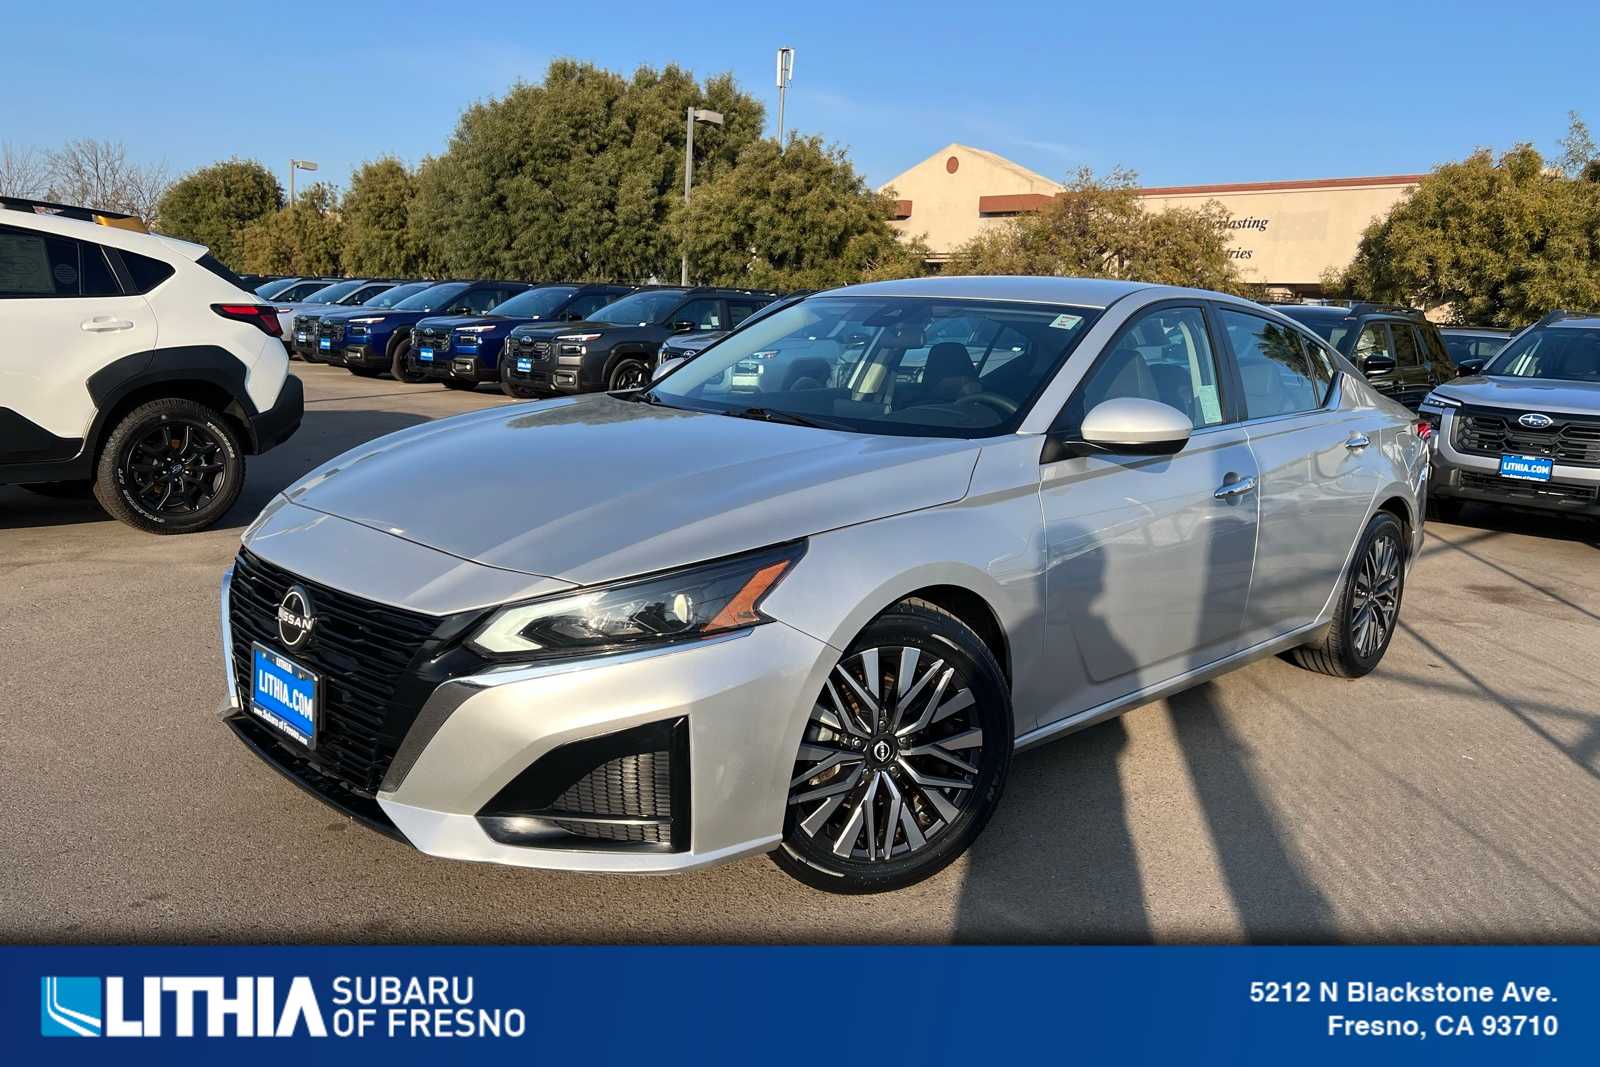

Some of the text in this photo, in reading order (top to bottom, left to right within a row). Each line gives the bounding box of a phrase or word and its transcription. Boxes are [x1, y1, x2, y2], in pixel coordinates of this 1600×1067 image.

[1199, 216, 1269, 231] erlasting
[278, 606, 312, 630] SSAN
[258, 669, 313, 722] LITHIA.COM
